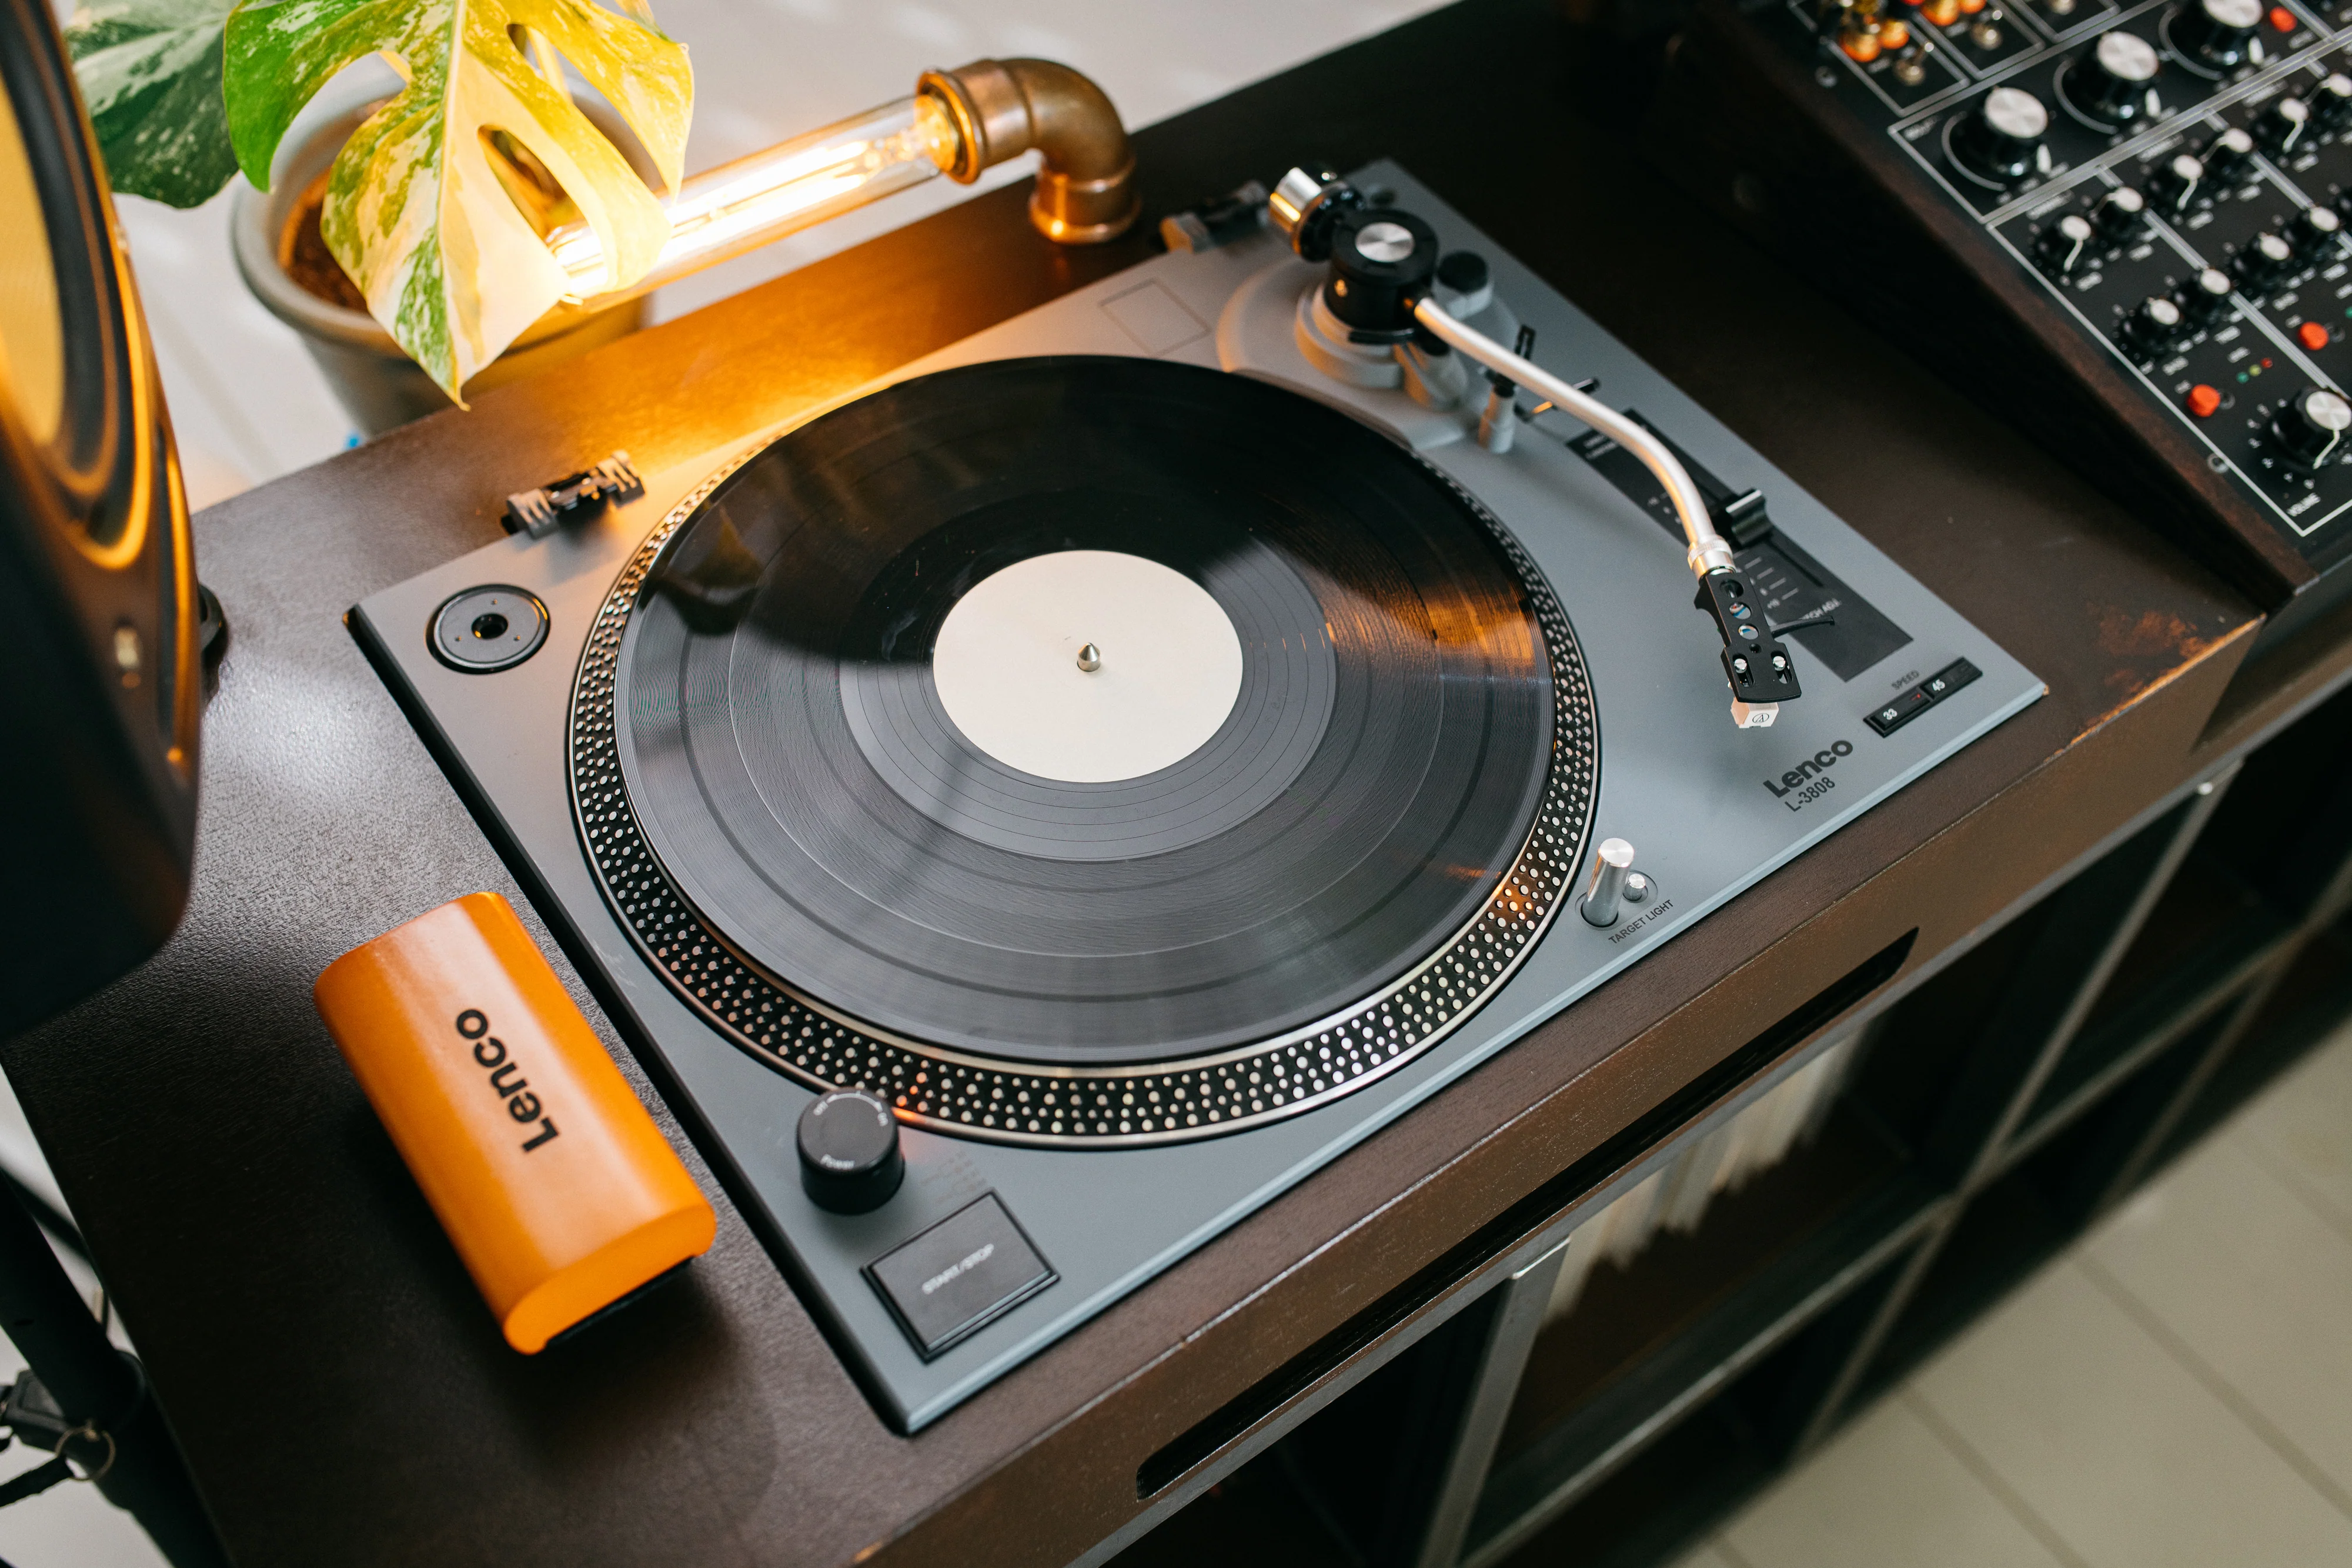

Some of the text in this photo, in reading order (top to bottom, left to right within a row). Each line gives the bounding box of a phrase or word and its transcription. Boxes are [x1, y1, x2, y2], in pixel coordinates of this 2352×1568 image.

[1891, 670, 1920, 690] SPEED
[1932, 678, 1946, 691] 45
[1883, 708, 1898, 720] 33
[1763, 740, 1853, 798] Lenco
[1785, 777, 1835, 812] L-3808
[1608, 900, 1673, 944] TARGET LIGHT
[456, 1009, 559, 1153] Lenco
[820, 1154, 856, 1170] Power
